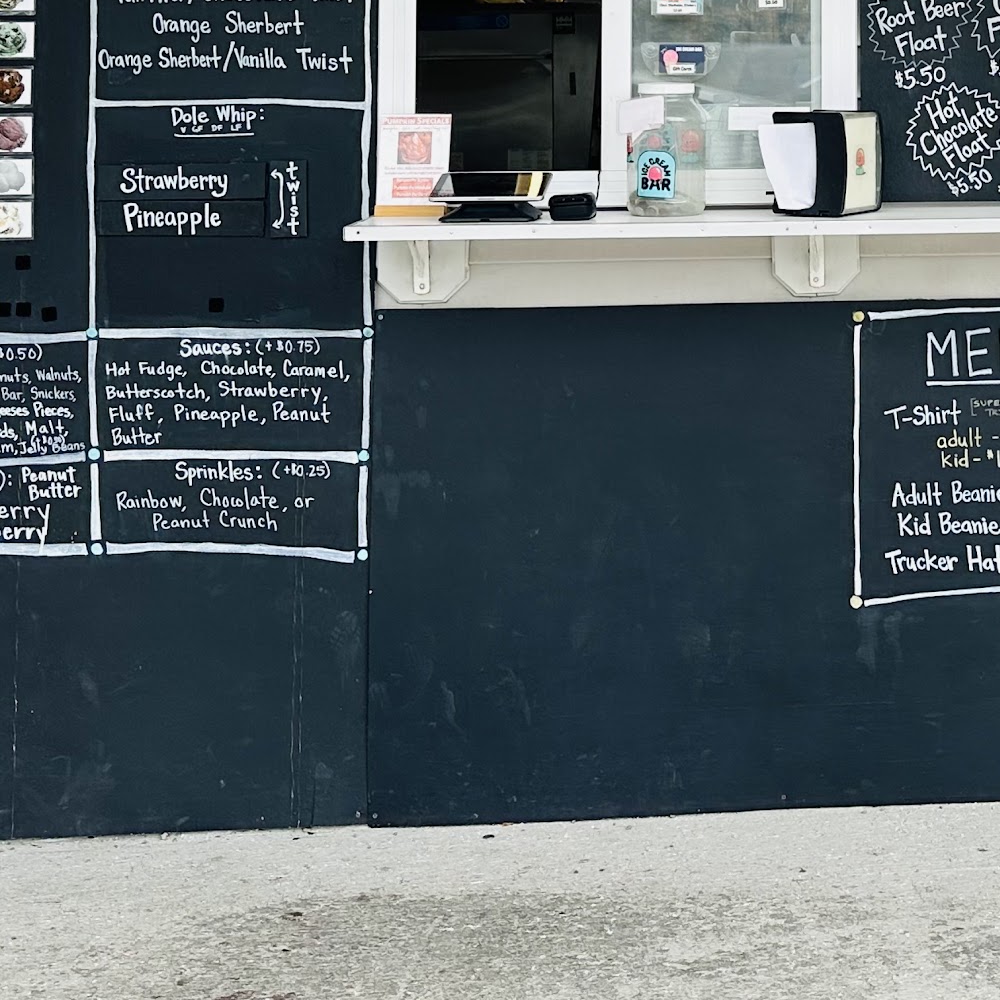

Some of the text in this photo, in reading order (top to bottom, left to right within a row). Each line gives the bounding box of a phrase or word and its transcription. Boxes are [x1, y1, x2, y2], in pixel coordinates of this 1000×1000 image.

[153, 10, 304, 43] Orange Sherbert
[875, 1, 915, 35] Root
[895, 25, 947, 57] Float
[895, 63, 945, 89] $5.50
[171, 105, 264, 131] Dole Whip:
[120, 166, 227, 197] Strawberry
[642, 177, 671, 191] BAR
[123, 203, 221, 235] Pineapple
[180, 339, 250, 360] Sauces:
[106, 359, 350, 382] Hot Fudge, Chocolate, Caramel,
[106, 381, 327, 405] Butterscotch, Strawberry,
[109, 401, 330, 428] Fluff, Pineapple, Peanut
[884, 400, 961, 429] T-Shirt
[112, 427, 162, 446] Butter
[937, 427, 982, 448] adult
[175, 461, 262, 486] Sprinkles:
[892, 482, 942, 507] Adult
[885, 549, 958, 574] Trucker
